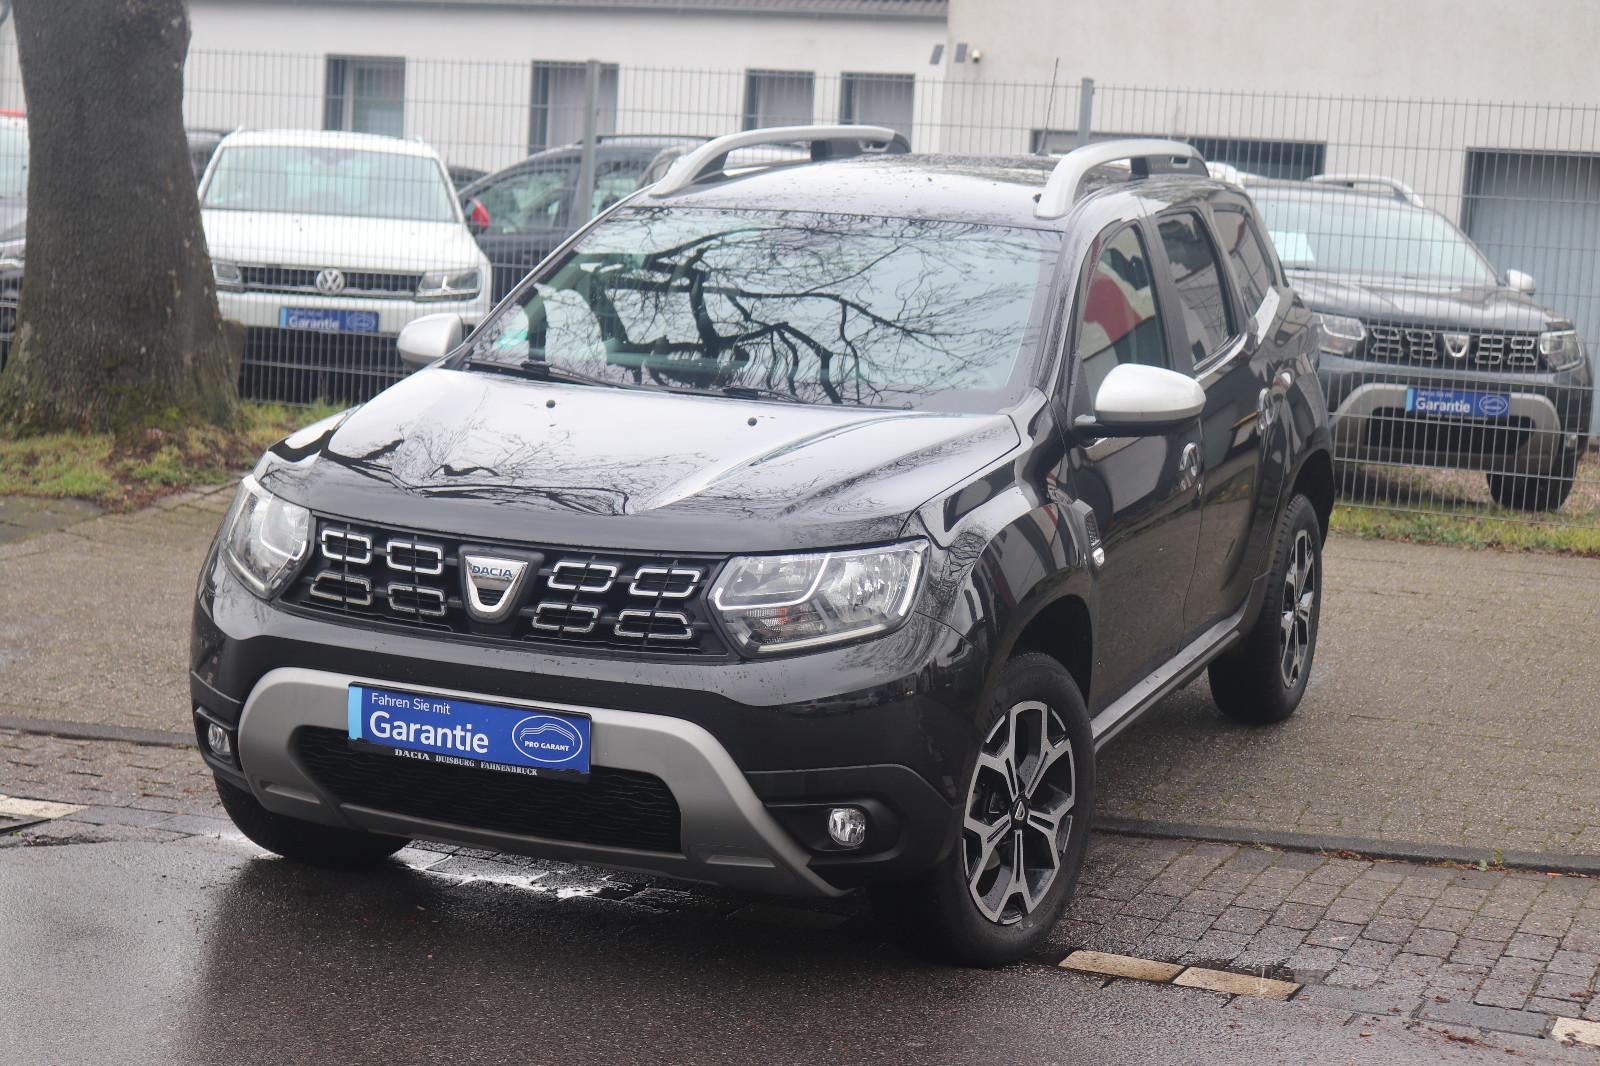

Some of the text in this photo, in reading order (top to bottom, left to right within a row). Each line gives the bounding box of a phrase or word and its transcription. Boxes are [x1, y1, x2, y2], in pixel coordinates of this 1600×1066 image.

[1416, 398, 1471, 413] Garantie
[471, 565, 513, 577] DACIA
[371, 693, 451, 715] Fahren Sie mit
[369, 711, 489, 754] Garantie
[541, 742, 570, 751] GARANT
[394, 748, 430, 760] DACIA
[435, 754, 475, 767] DUISBURG
